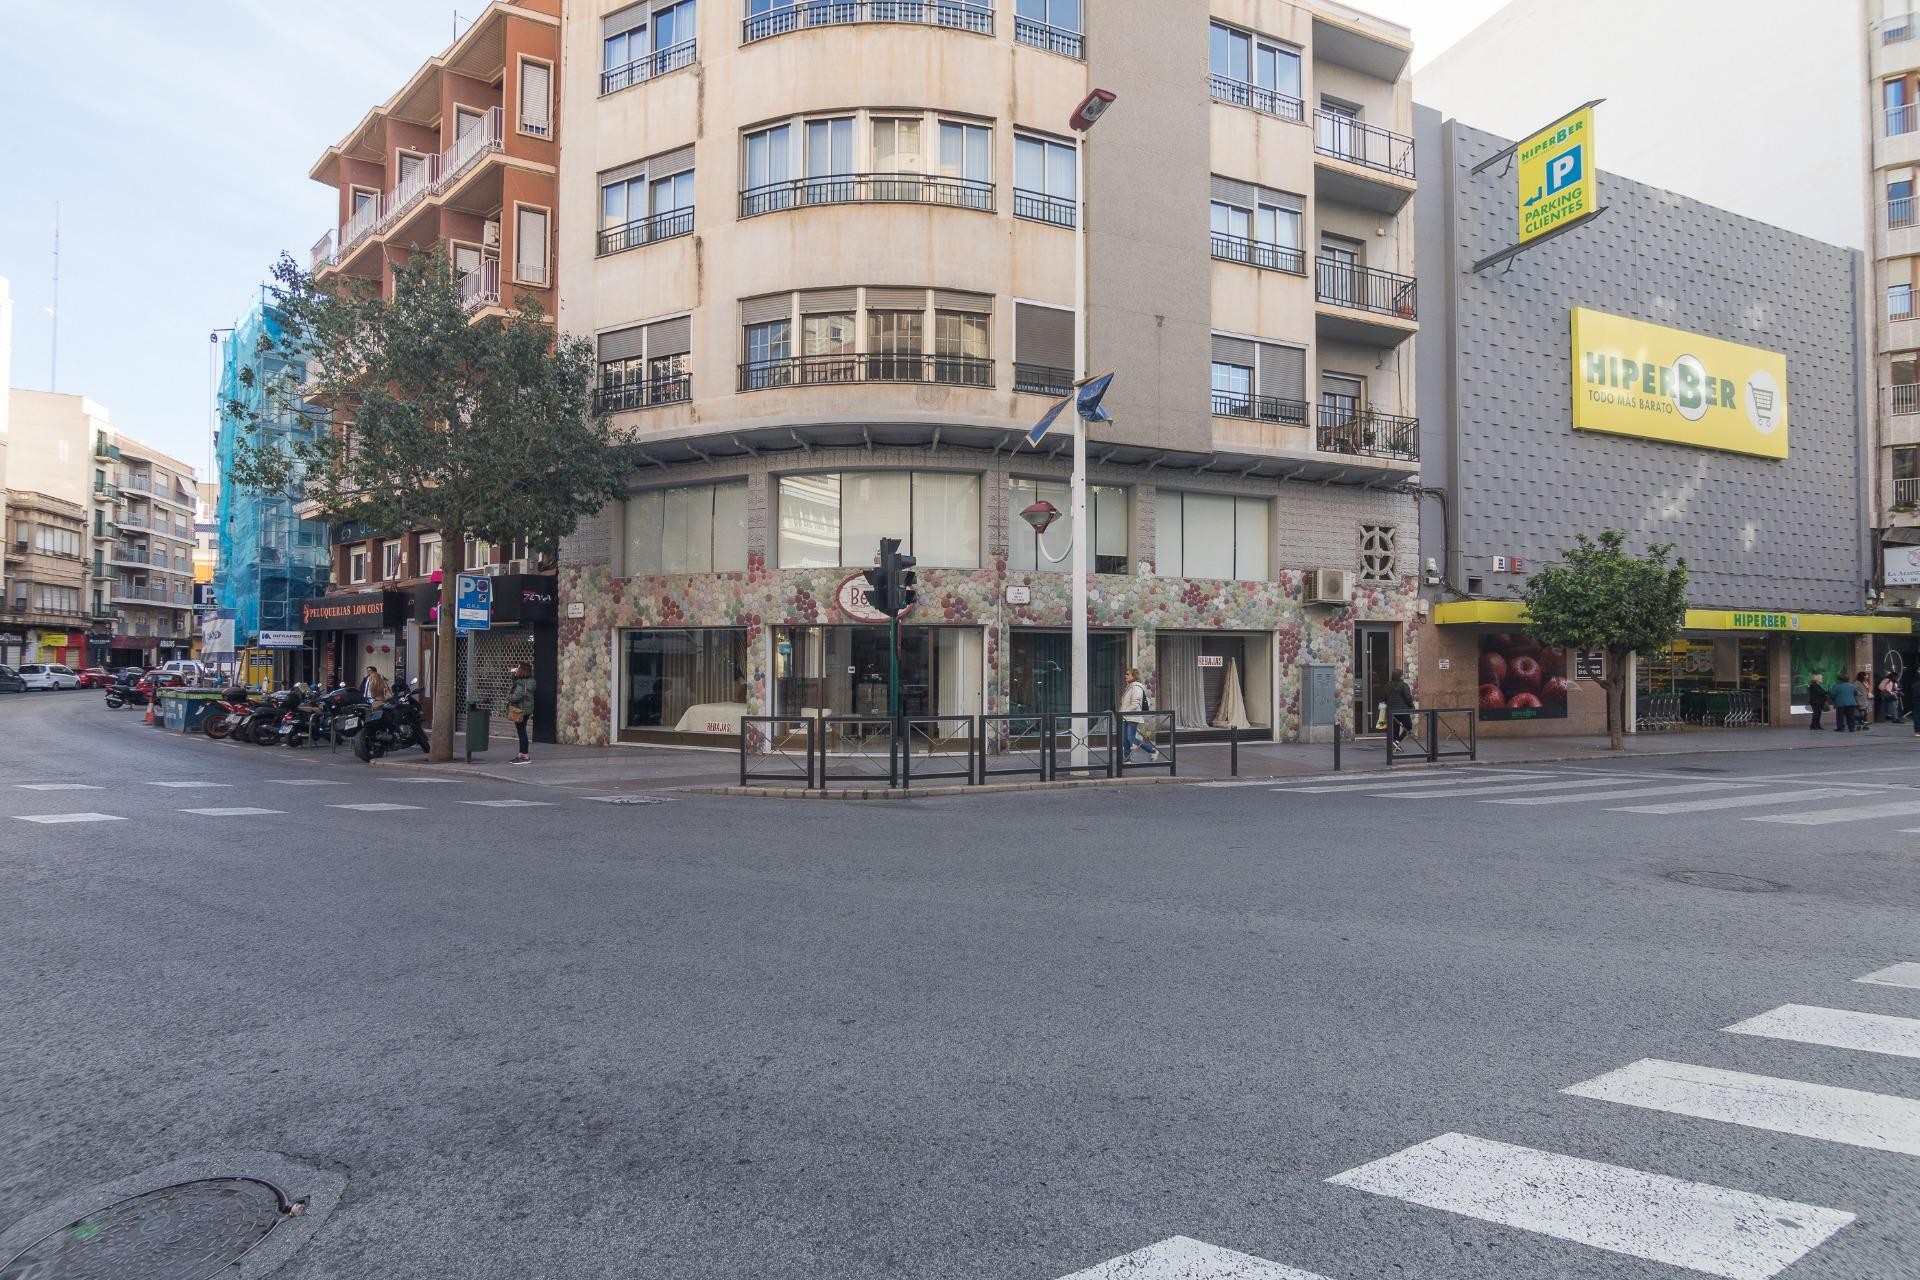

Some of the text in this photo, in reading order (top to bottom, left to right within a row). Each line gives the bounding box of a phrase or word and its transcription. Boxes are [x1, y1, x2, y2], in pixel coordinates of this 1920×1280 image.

[1521, 120, 1583, 162] HIPERBER
[1553, 155, 1575, 190] P
[1525, 187, 1583, 223] PARKING
[1525, 199, 1584, 234] CLIENTES
[1586, 351, 1737, 410] HIPERBER
[1588, 389, 1614, 404] TODO
[1639, 398, 1673, 414] BARATO
[459, 577, 476, 599] P
[309, 602, 384, 619] PELUQUERIAS LOW COST
[1734, 613, 1787, 628] HIPERBER
